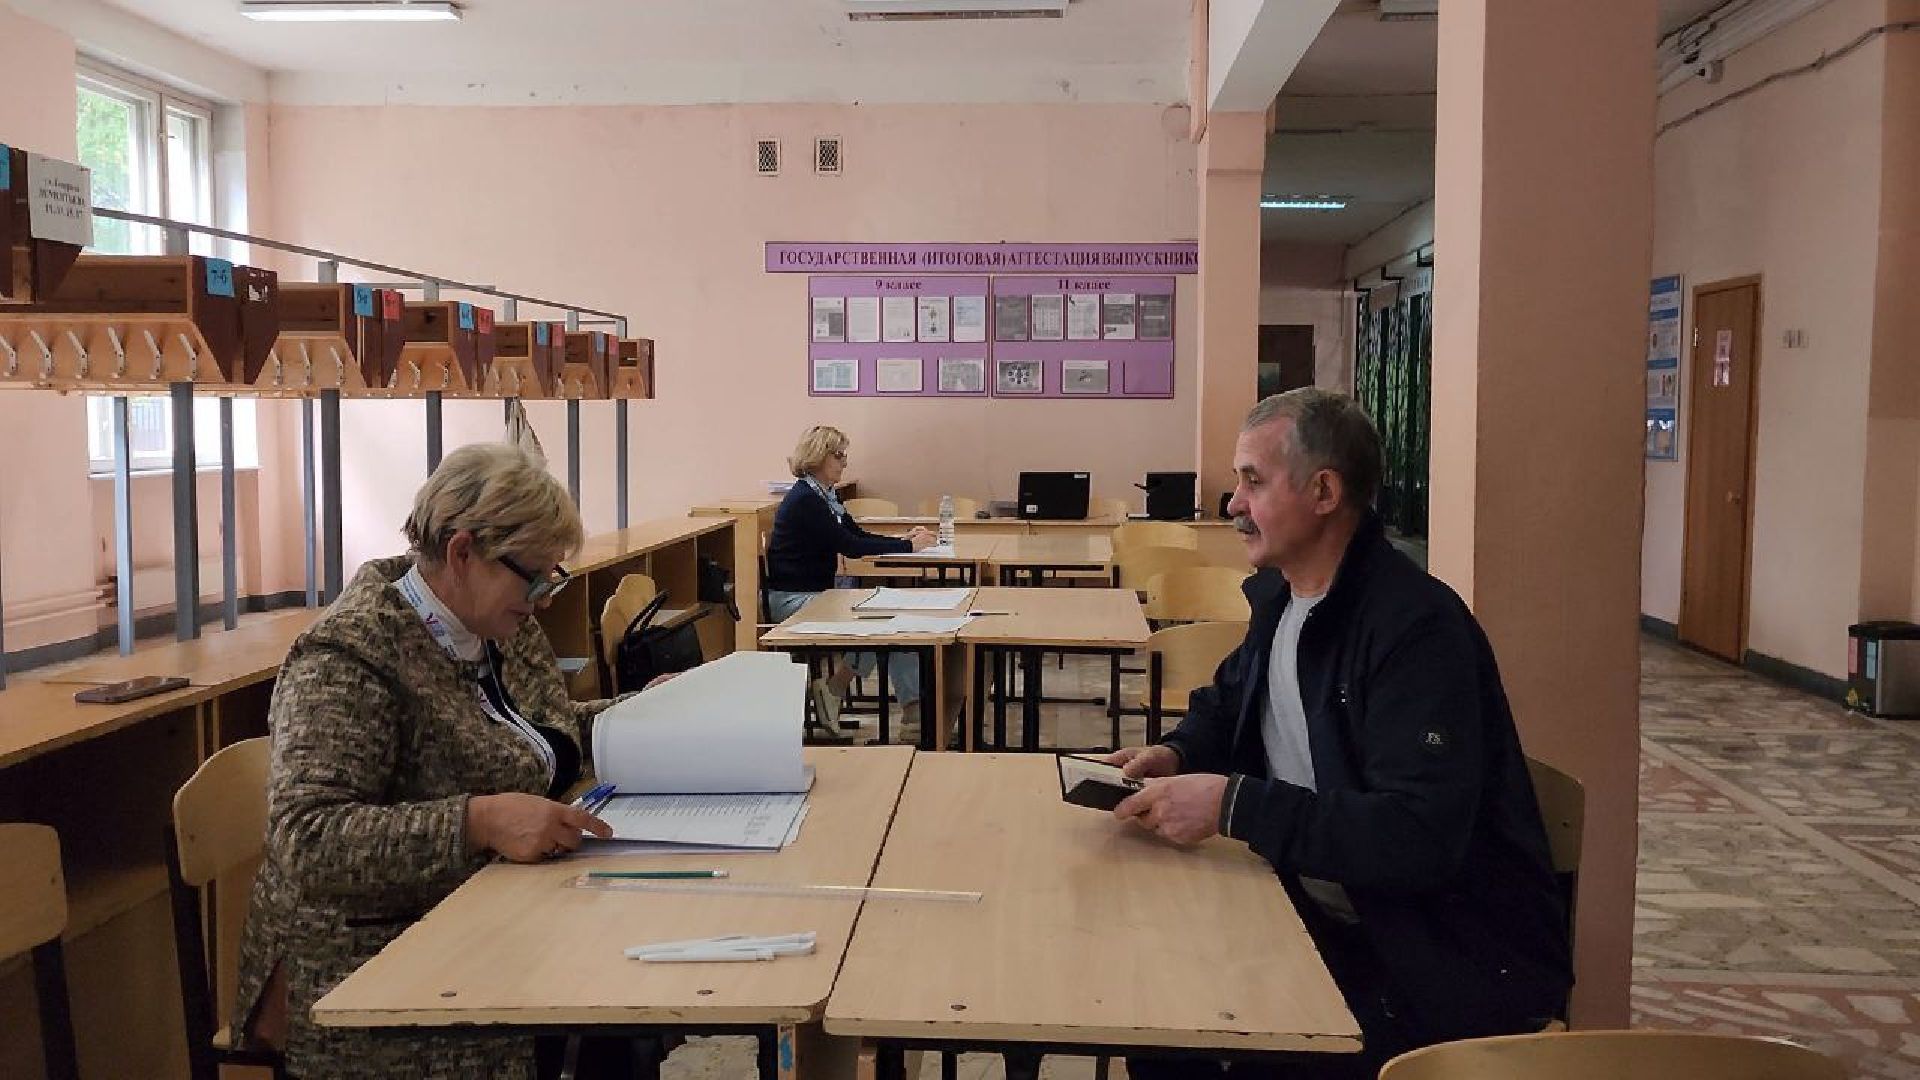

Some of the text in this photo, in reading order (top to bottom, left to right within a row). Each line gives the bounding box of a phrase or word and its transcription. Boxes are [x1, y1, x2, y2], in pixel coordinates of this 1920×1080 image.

[779, 251, 916, 267] ГОСУДАРСТВЕННАЯ
[921, 251, 1006, 267] (ИТОГОВАЯ)
[1007, 251, 1100, 267] АТТЕСТАЦИЯ
[875, 279, 922, 290] 9 класс
[1058, 279, 1111, 290] 11 класс
